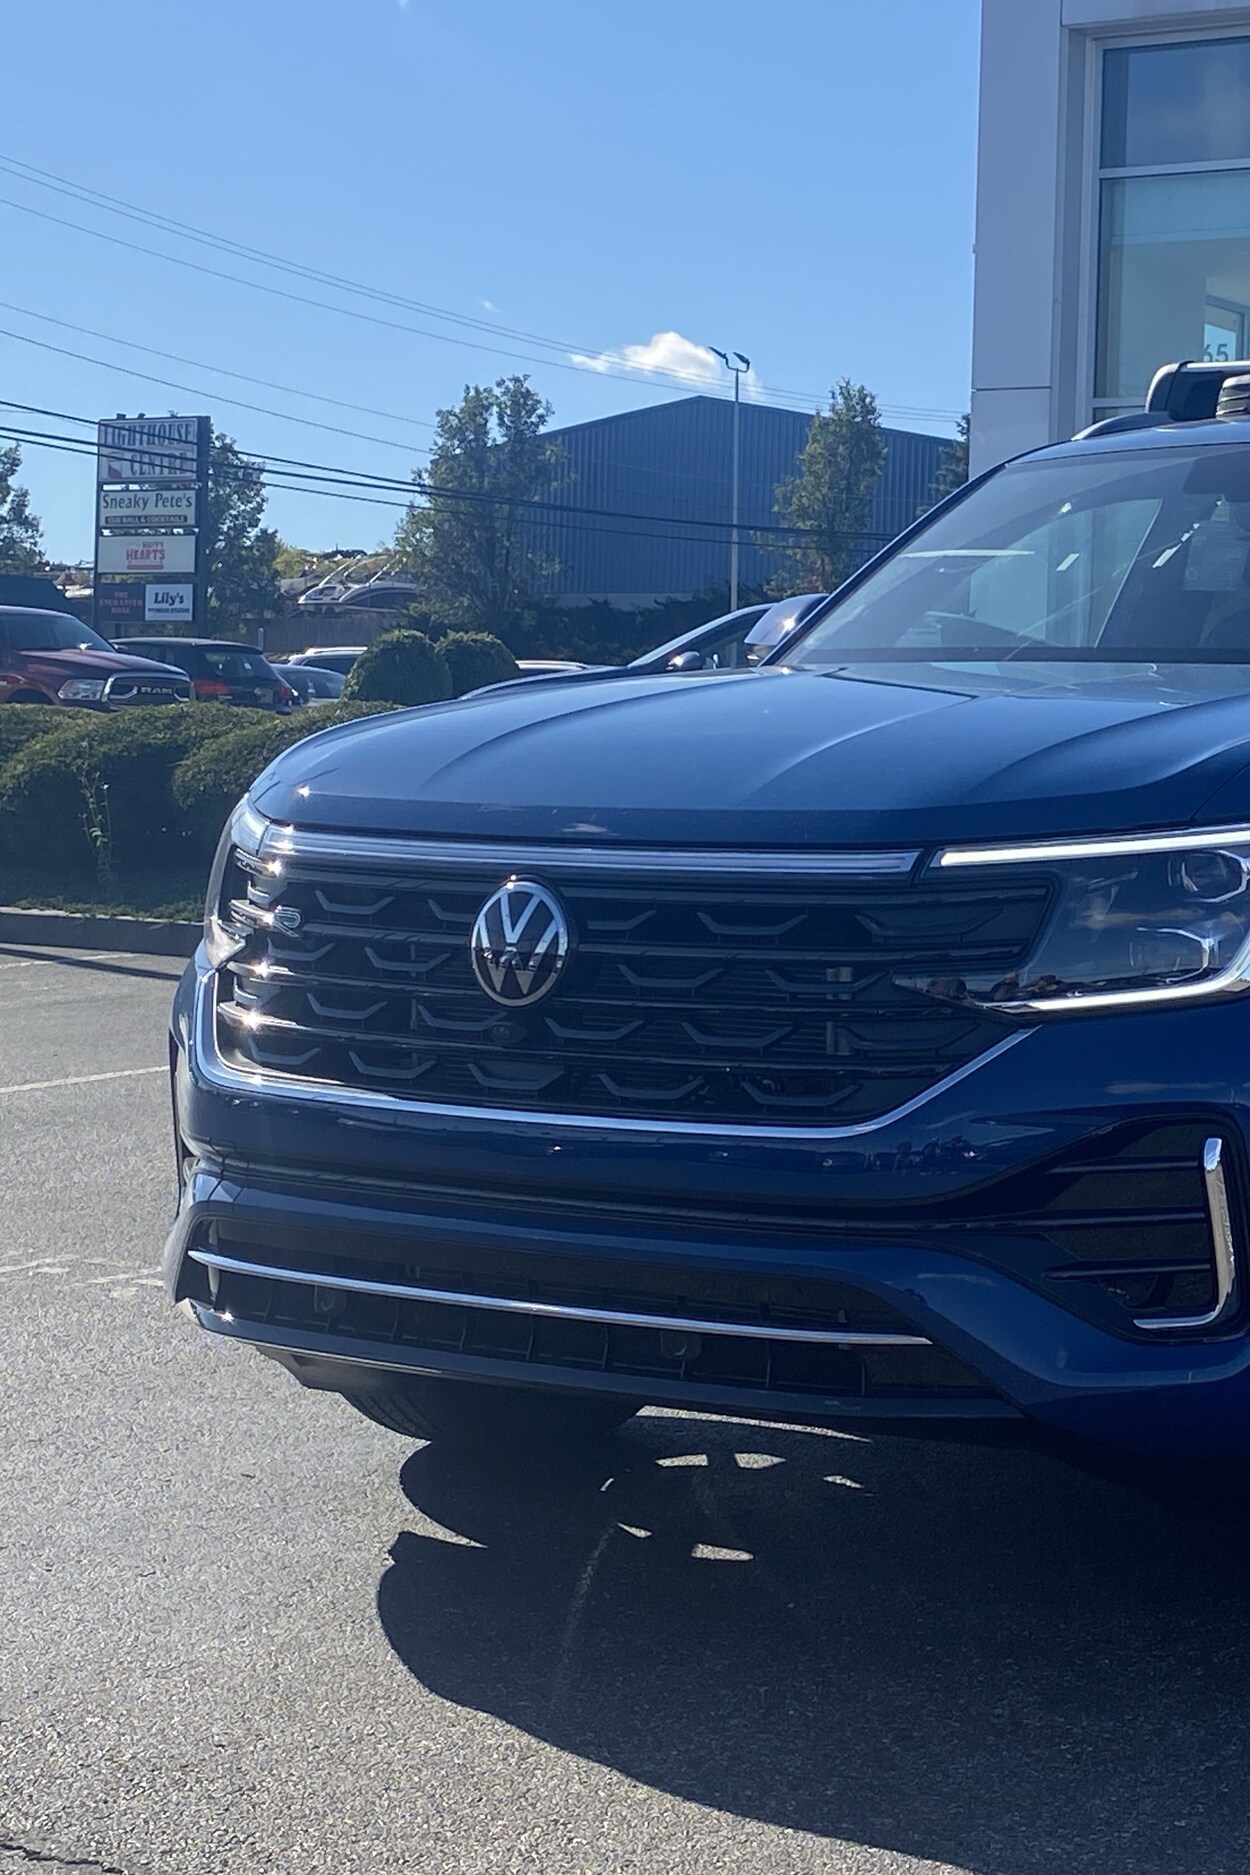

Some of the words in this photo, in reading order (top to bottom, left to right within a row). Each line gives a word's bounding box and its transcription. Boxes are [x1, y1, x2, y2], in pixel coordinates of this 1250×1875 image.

[104, 423, 192, 446] LIGHTHOUSE
[131, 453, 187, 476] CENTRE
[103, 494, 149, 511] Sneaky
[154, 492, 193, 508] Pete's
[126, 549, 166, 561] HEARTS
[153, 591, 184, 606] Lily's
[140, 686, 172, 694] RAM
[474, 884, 564, 1000] VW
